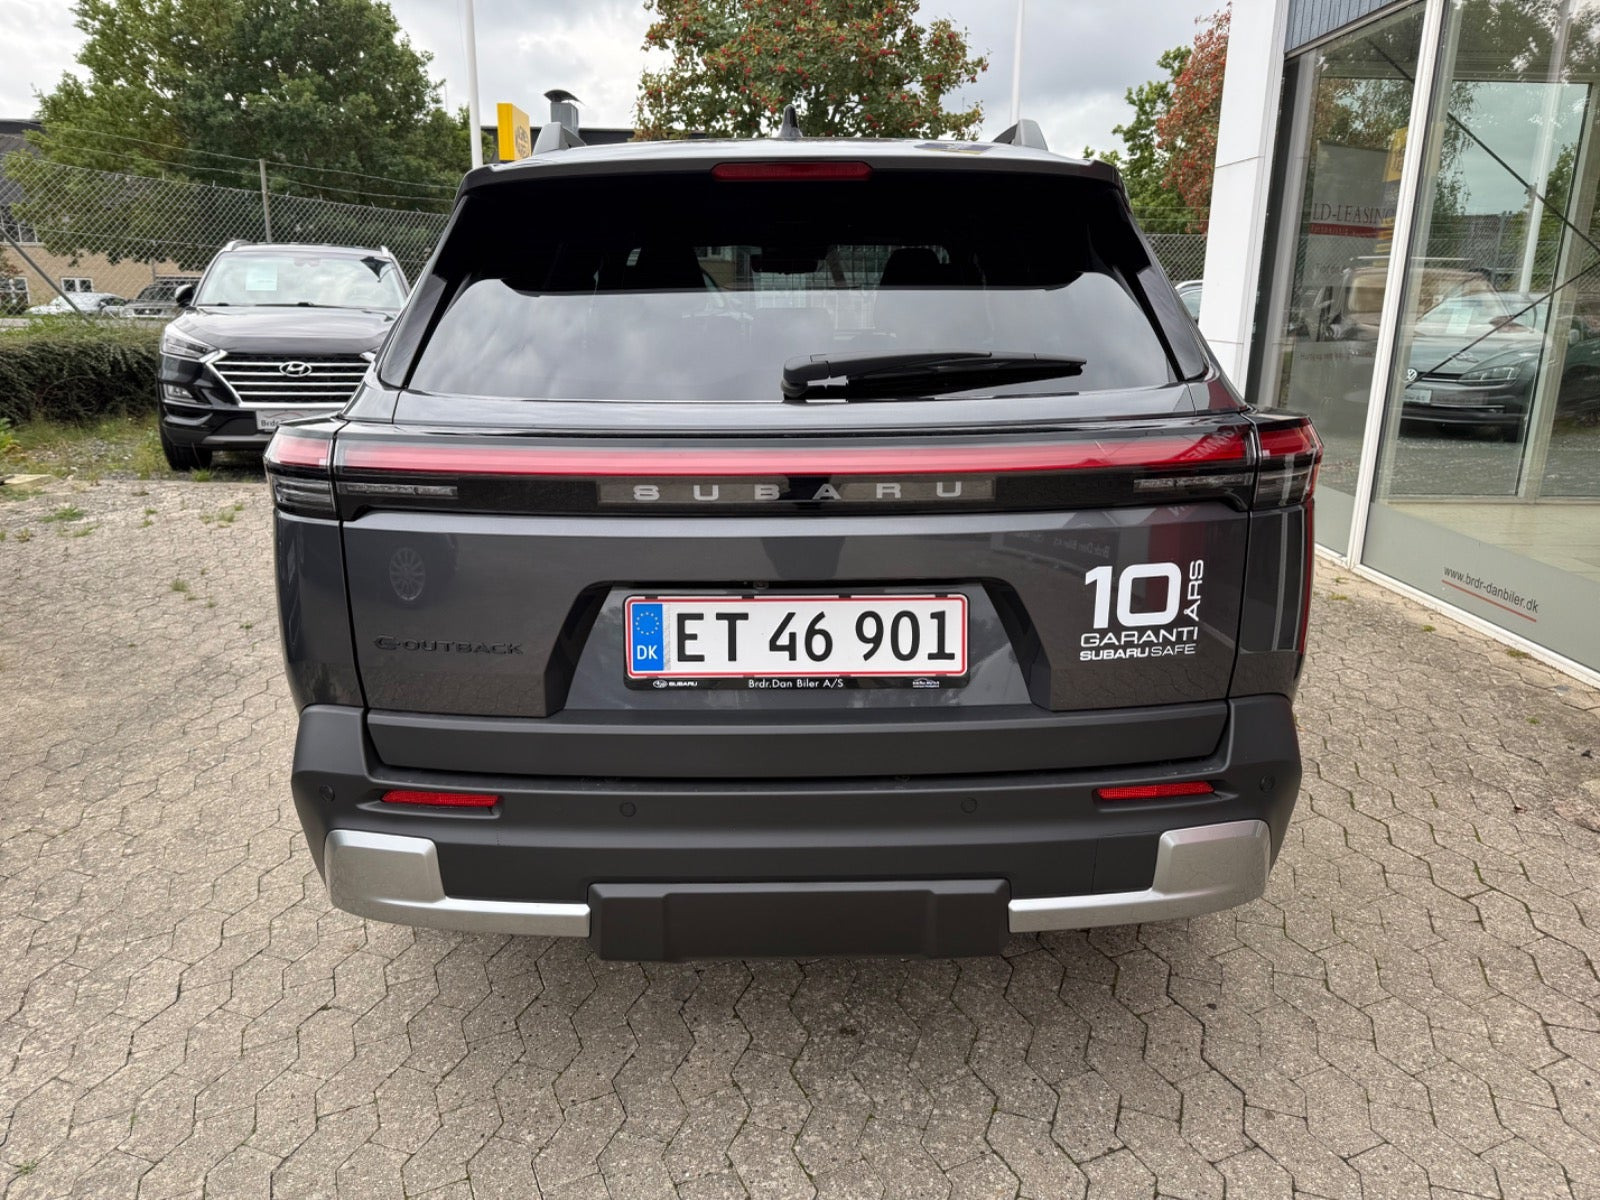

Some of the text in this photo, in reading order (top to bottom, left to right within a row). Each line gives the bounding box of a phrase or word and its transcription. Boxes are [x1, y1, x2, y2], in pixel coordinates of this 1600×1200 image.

[632, 481, 962, 502] SUBARU
[1084, 561, 1182, 629] 10
[1183, 559, 1204, 622] ÅRS
[1443, 566, 1539, 614] www.brdr-danbiler.dk
[636, 644, 658, 660] DK
[676, 610, 956, 662] ET 46 901
[1080, 626, 1198, 648] GARANTI
[796, 678, 819, 688] Biler
[822, 678, 844, 688] A/S
